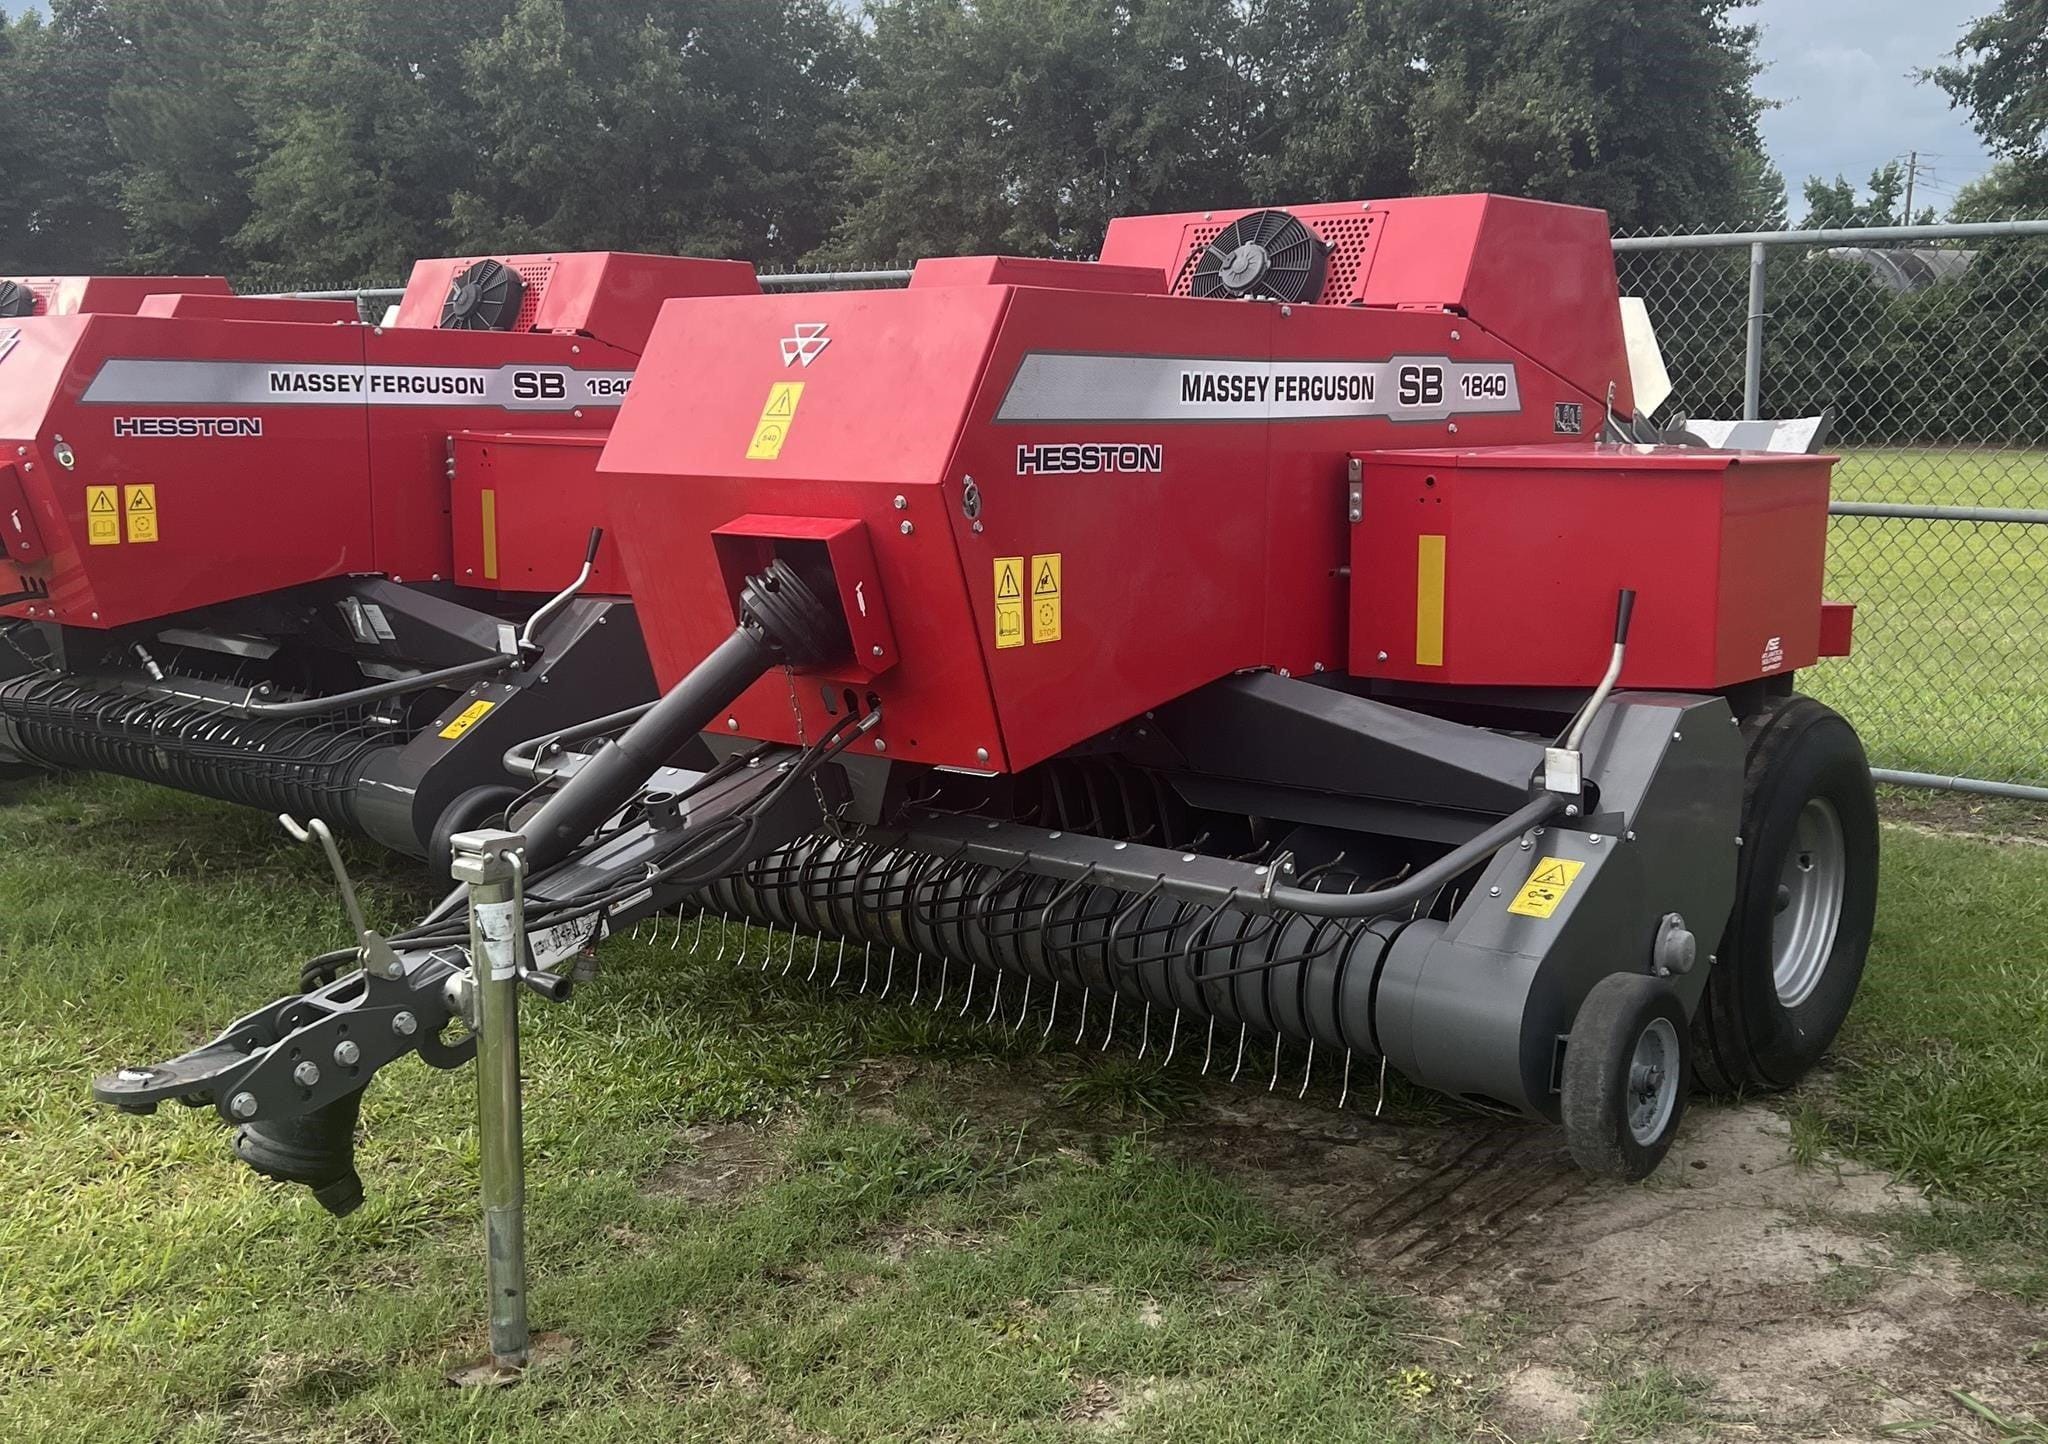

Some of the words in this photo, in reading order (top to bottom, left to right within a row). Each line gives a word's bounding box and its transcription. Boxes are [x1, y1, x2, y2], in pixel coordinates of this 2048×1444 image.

[269, 372, 364, 393] MASSEY
[370, 374, 486, 395] FERGUSON
[512, 372, 567, 399] SB
[1181, 372, 1269, 402] MASSEY
[1274, 374, 1375, 402] FERGUSON
[1399, 365, 1444, 406] SB
[1461, 373, 1507, 399] 1840
[114, 417, 263, 436] HESSTON
[1017, 444, 1162, 474] HESSTON
[1039, 627, 1056, 638] STOP
